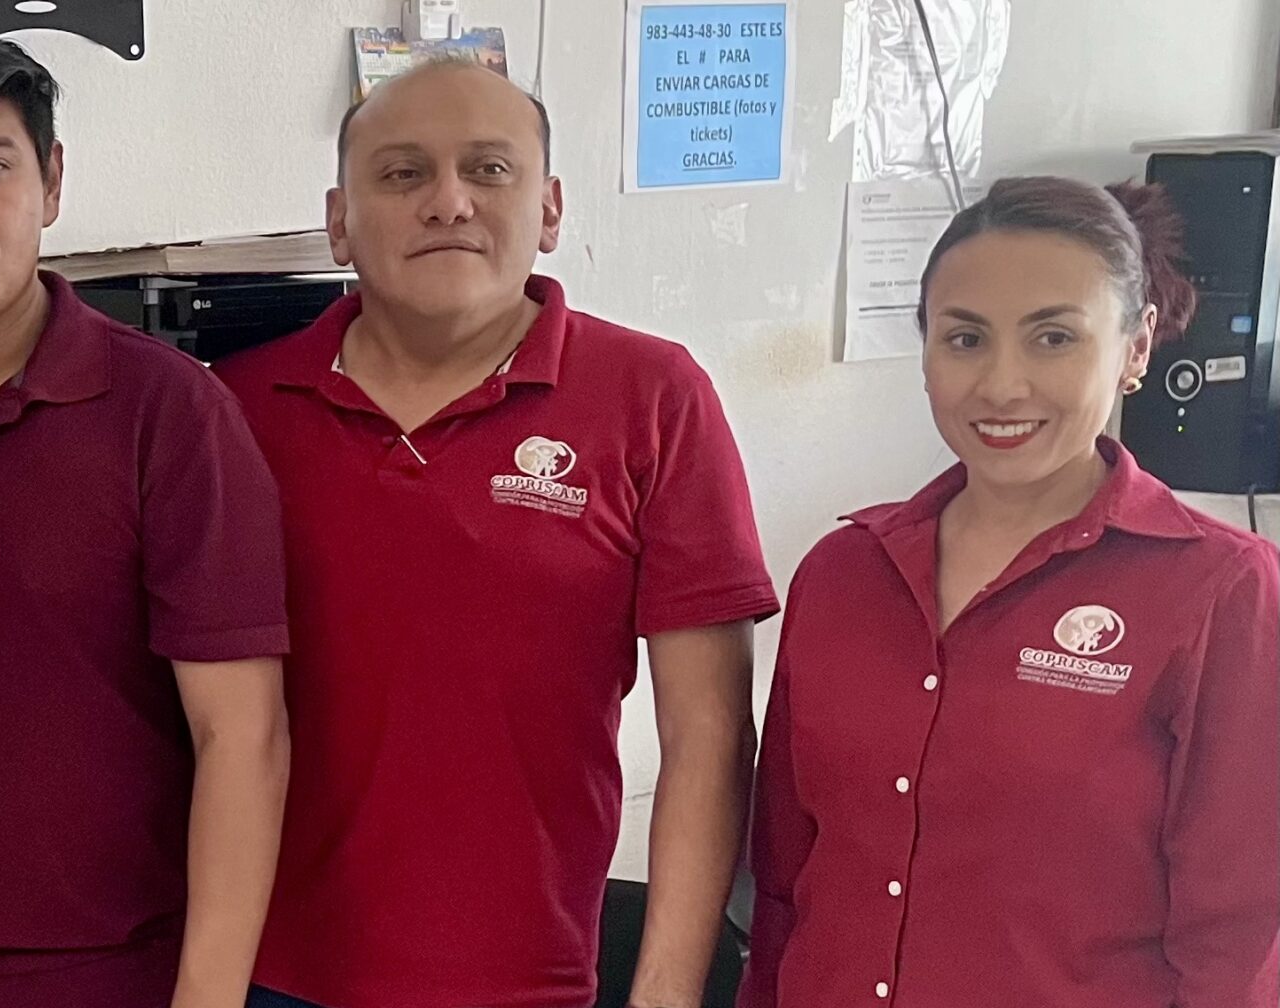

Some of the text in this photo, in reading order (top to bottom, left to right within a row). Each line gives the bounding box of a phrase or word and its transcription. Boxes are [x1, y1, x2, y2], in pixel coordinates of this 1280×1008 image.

[646, 22, 783, 40] 983-443-48-30 ESTE ES
[676, 50, 689, 65] EL
[719, 48, 751, 64] PARA
[656, 73, 769, 92] ENVIAR CARGAS DE
[646, 99, 777, 118] COMBUSTIBLE (fotos y
[690, 125, 733, 143] tickets)
[682, 151, 737, 169] GRACIAS.
[491, 475, 587, 503] COPRISCAM
[1019, 647, 1132, 679] COPRISCAM
